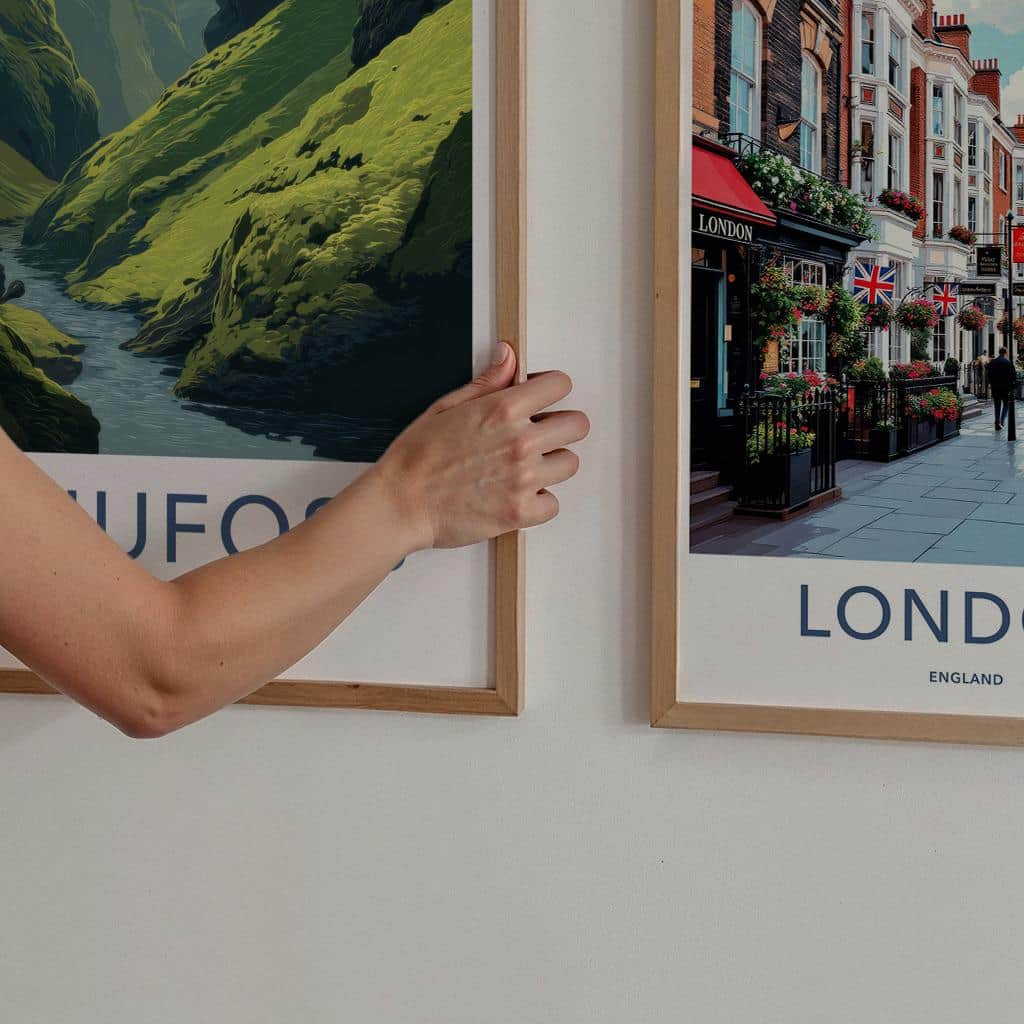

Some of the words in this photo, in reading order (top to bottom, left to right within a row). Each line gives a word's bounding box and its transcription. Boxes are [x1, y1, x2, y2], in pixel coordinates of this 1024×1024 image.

[699, 213, 753, 242] LONDON
[800, 584, 1024, 644] LOND
[929, 671, 1004, 686] ENGLAND
